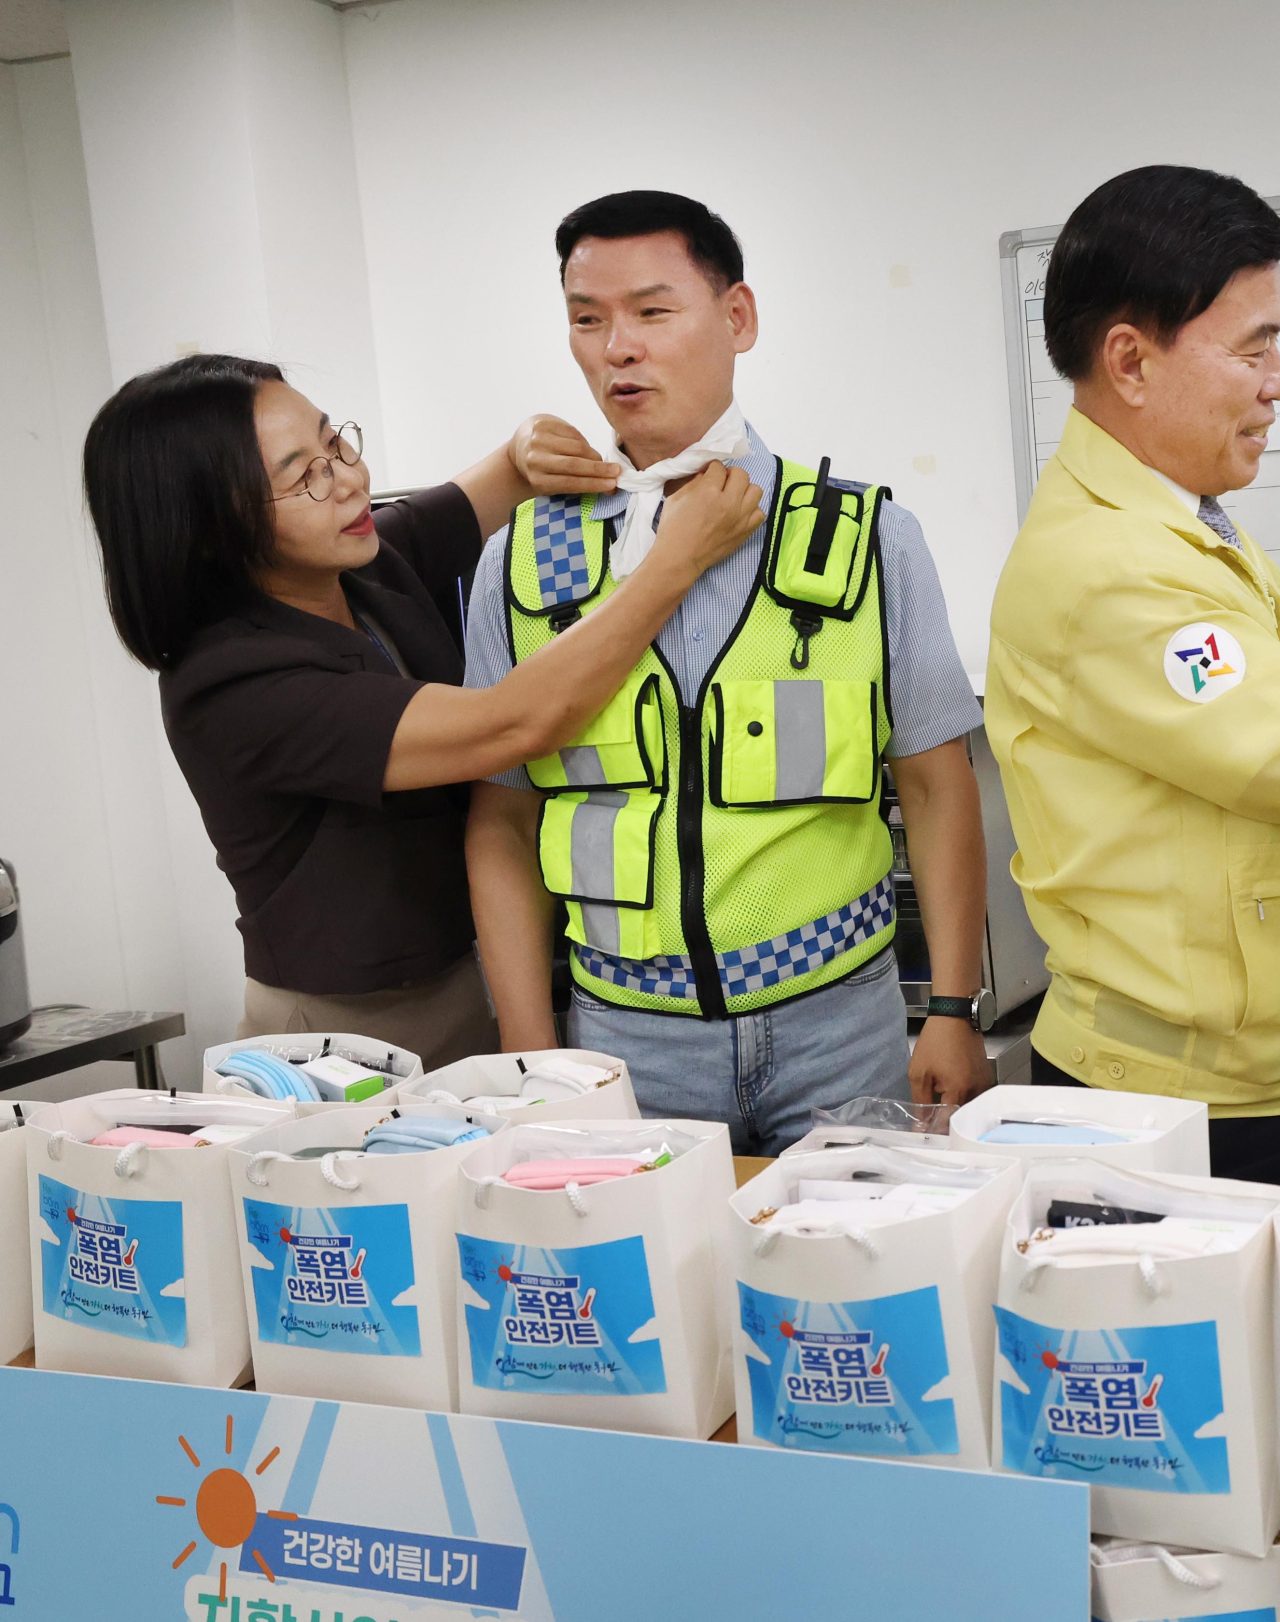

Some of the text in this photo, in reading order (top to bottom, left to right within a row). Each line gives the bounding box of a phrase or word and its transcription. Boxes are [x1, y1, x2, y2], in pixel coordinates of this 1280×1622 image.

[79, 1229, 122, 1266] 폭염
[69, 1256, 138, 1291] 안전키트
[296, 1249, 348, 1280] 폭염
[288, 1278, 367, 1305] 안전키트
[517, 1288, 577, 1320] 폭염
[505, 1319, 599, 1345] 안전키트
[801, 1345, 868, 1378] 폭염
[787, 1376, 891, 1403] 안전키트
[1065, 1376, 1138, 1410] 폭염
[1048, 1408, 1161, 1437] 안전키트
[283, 1529, 478, 1591] 건강한 여름나기
